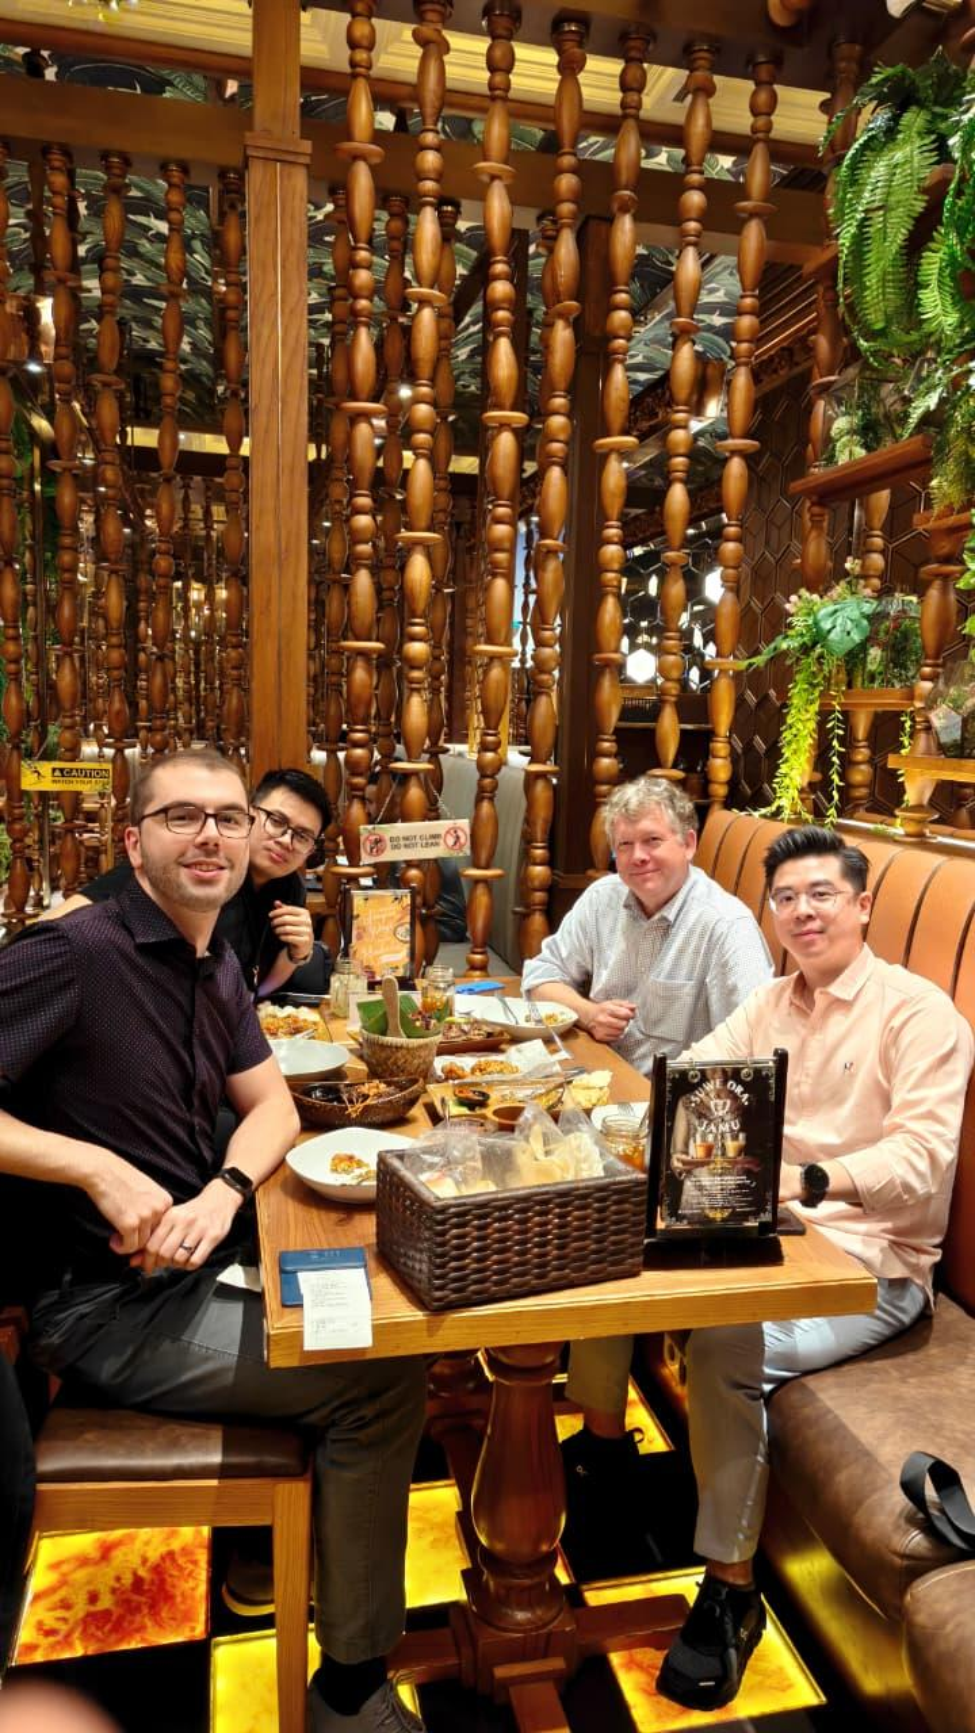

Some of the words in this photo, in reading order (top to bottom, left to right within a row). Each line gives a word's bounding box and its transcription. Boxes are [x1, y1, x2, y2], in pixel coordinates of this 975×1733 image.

[63, 768, 109, 778] CAUTION
[402, 834, 417, 842] NOT
[420, 841, 440, 849] LEAN
[727, 1079, 750, 1103] ORA
[696, 1118, 741, 1133] JAMU
